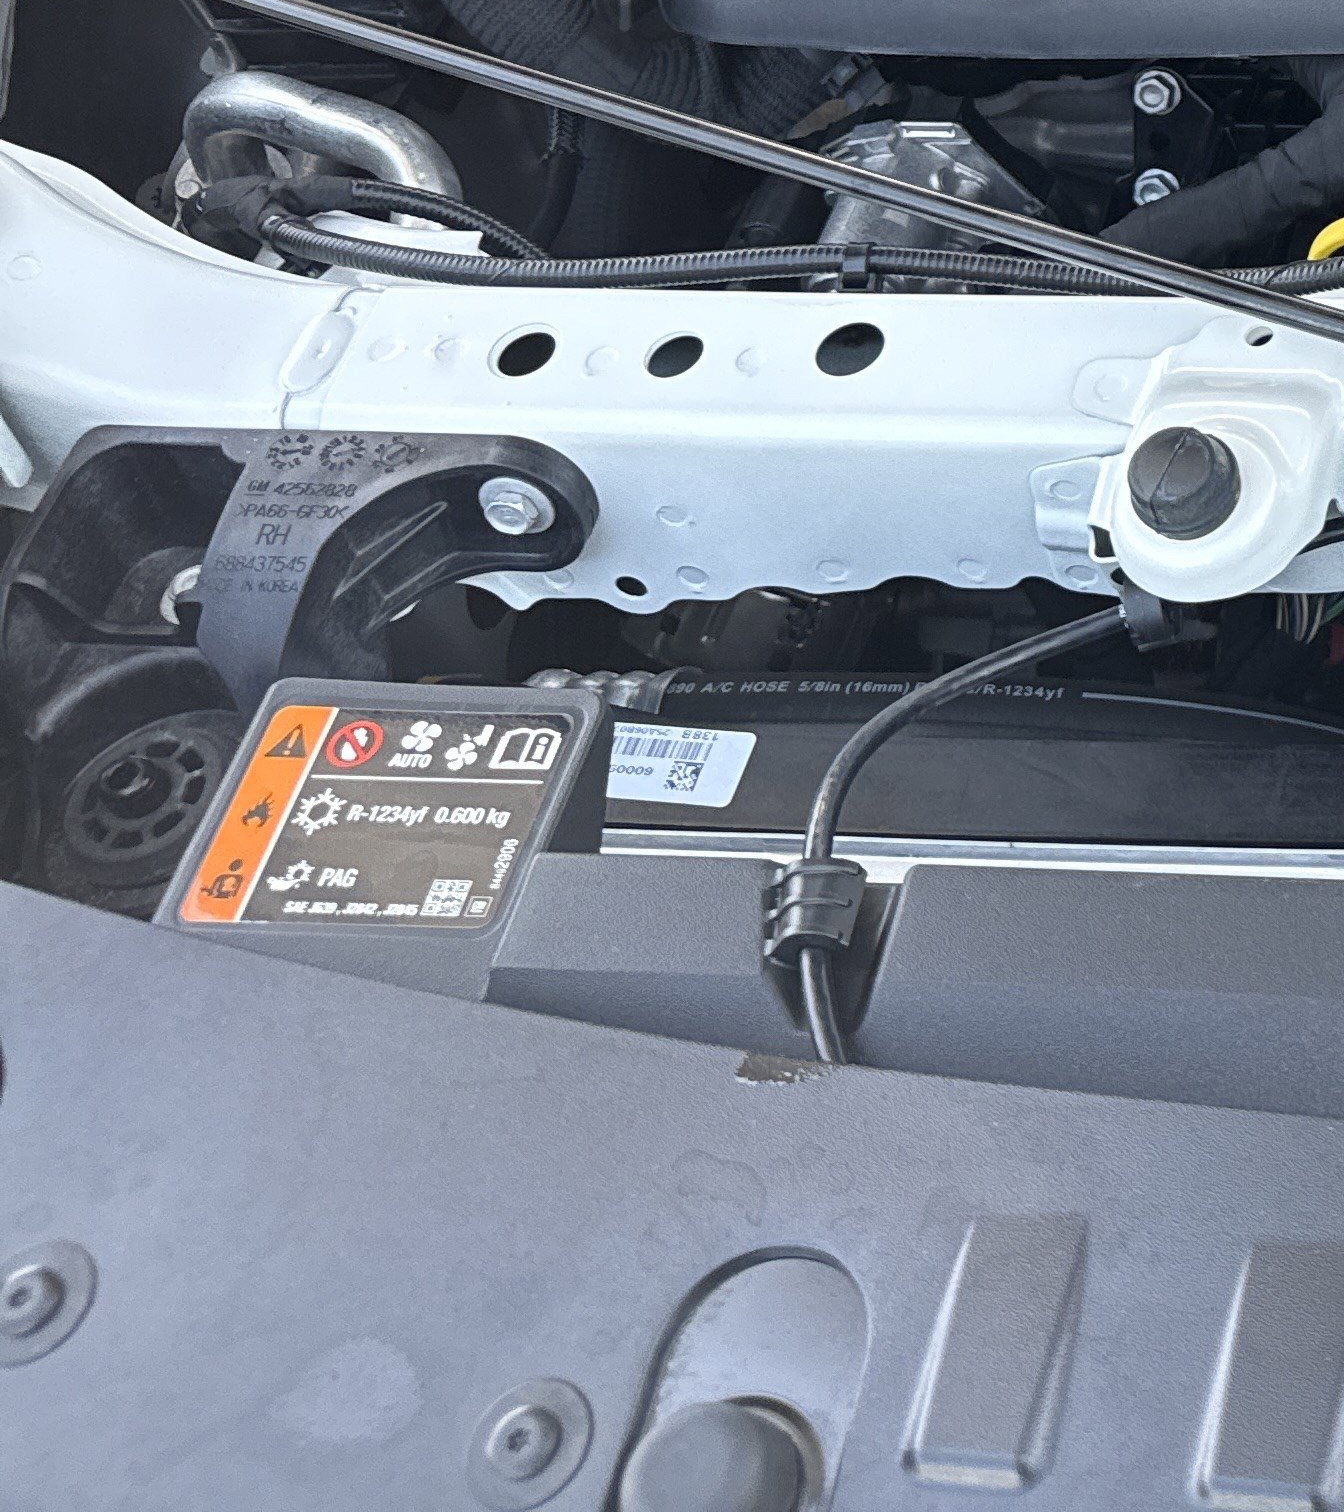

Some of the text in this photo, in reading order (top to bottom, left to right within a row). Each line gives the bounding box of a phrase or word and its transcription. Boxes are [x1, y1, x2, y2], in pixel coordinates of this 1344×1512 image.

[255, 523, 291, 545] RH
[256, 580, 299, 593] KOREA
[700, 680, 735, 695] A/C
[740, 680, 789, 694] HOSE
[845, 681, 911, 696] (16mm)
[387, 753, 433, 769] AUTO
[345, 804, 512, 829] R-1234yf 0.600 kg
[316, 867, 359, 888] PAG
